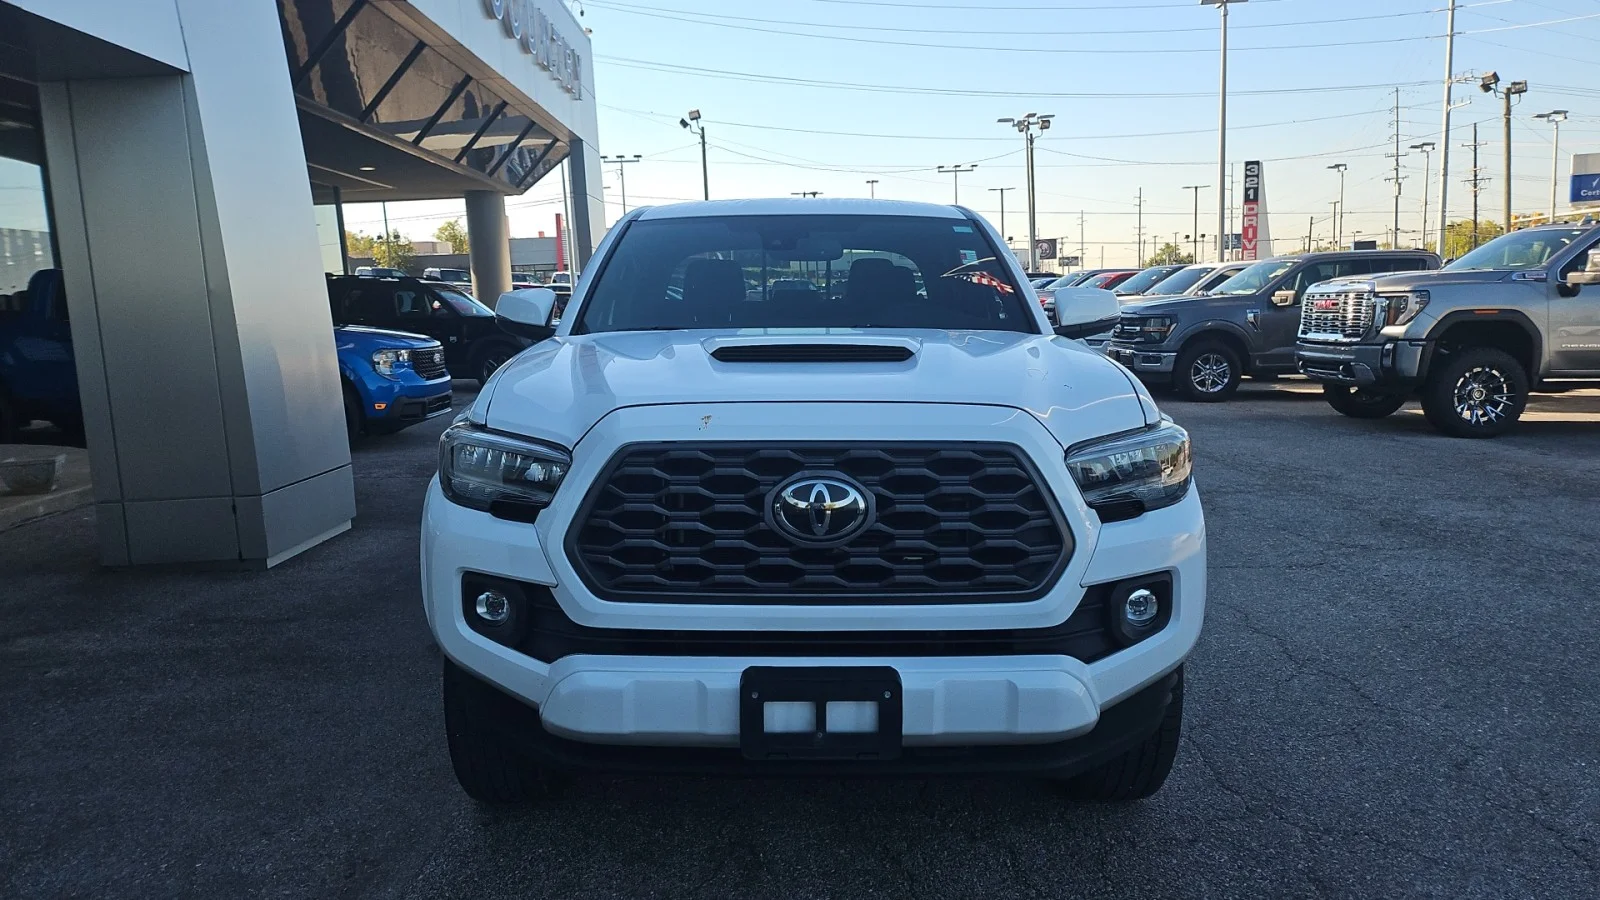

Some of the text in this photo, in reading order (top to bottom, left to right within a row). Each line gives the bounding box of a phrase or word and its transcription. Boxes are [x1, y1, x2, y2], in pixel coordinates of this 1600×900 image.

[1243, 164, 1259, 260] 321 DRIVE
[1315, 300, 1340, 310] GMC
